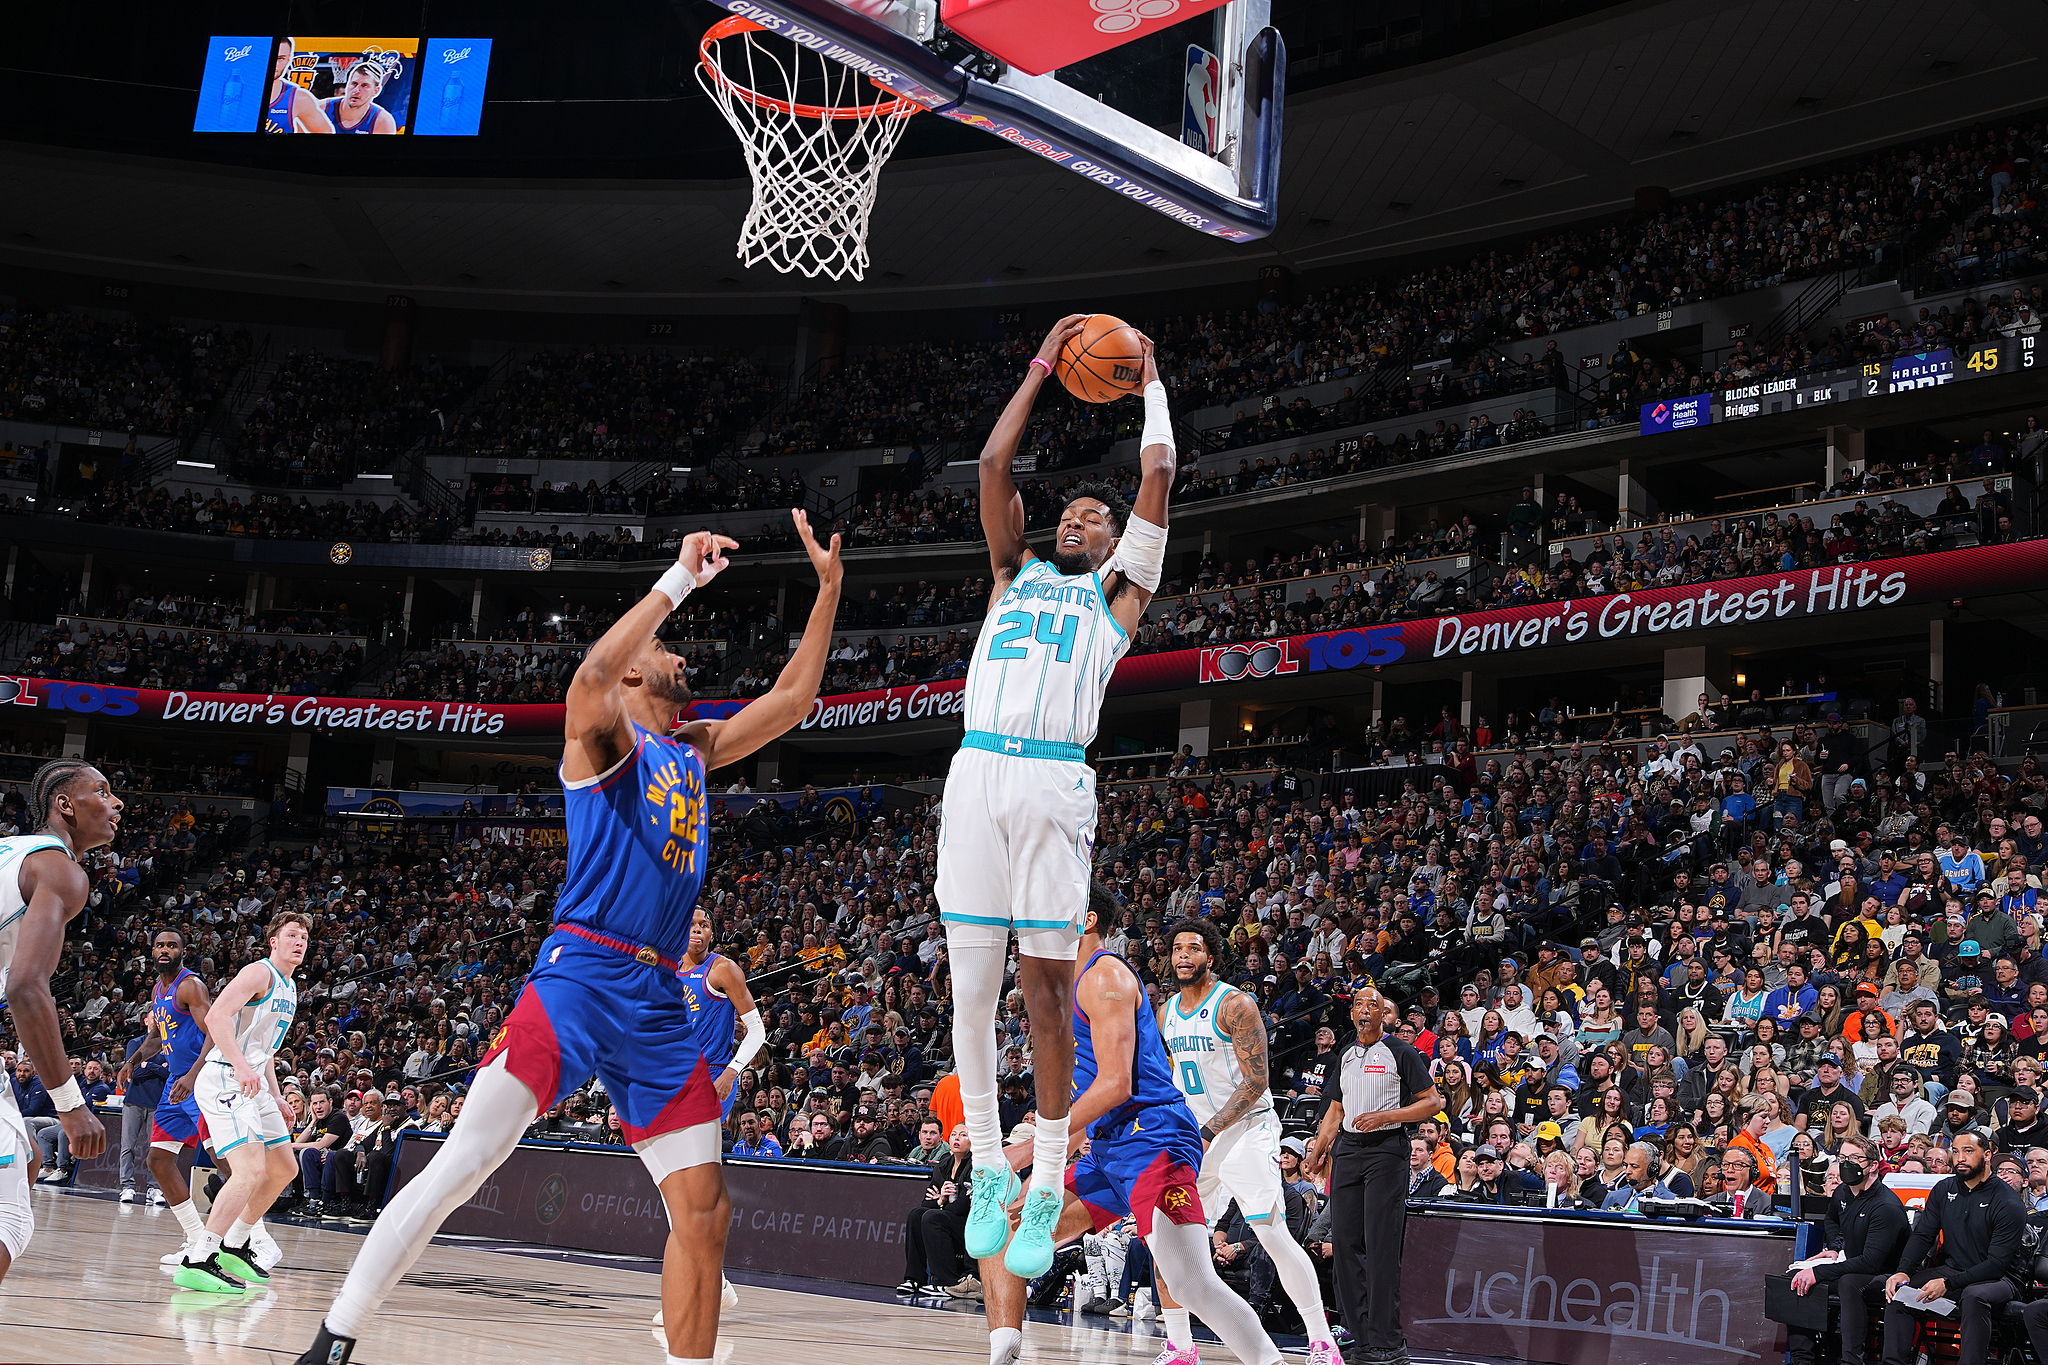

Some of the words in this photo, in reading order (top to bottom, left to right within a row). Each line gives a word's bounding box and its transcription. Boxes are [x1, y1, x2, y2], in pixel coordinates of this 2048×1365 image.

[727, 0, 787, 30] GIVES
[783, 25, 824, 49] YOU
[224, 45, 252, 61] Ball
[443, 47, 471, 63] Ball
[1186, 128, 1203, 151] NBA
[998, 127, 1033, 148] Red
[1032, 137, 1074, 163] Bull
[1070, 160, 1121, 186] GIVES
[1115, 180, 1153, 202] YOU
[1657, 310, 1673, 320] 380
[650, 324, 672, 334] 372
[1658, 320, 1670, 330] EXIT
[1731, 328, 1746, 339] 302
[2021, 336, 2035, 350] TO
[1586, 358, 1600, 368] 378
[1966, 348, 1999, 373] 45
[2023, 351, 2035, 368] 5
[1113, 363, 1139, 383] Wil
[1863, 363, 1881, 377] FLS
[1725, 385, 1760, 402] BLOCKS
[1763, 378, 1797, 395] LEADER
[1867, 379, 1879, 395] 2
[1672, 400, 1698, 412] Select
[1725, 402, 1760, 418] Bridges
[1813, 388, 1832, 402] BLK
[1672, 409, 1697, 420] Health
[883, 448, 895, 456] 374
[1339, 440, 1358, 453] 379
[825, 479, 836, 487] 372
[1995, 478, 2012, 491] EXIT
[260, 494, 279, 505] 369
[1457, 557, 1469, 568] EXIT
[1432, 601, 1590, 659] Denver's
[1597, 578, 1796, 639] Greatest
[1805, 567, 1908, 614] Hits
[987, 610, 1080, 664] 24
[1300, 626, 1406, 672] 105
[41, 681, 140, 716] 105
[162, 691, 286, 726] Denver's
[290, 694, 433, 731] Greatest
[438, 702, 505, 734] Hits
[800, 689, 903, 730] Denver's
[907, 684, 966, 720] Grea
[1851, 725, 1868, 738] EXIT
[646, 762, 682, 808] MILE
[1284, 779, 1296, 791] 50
[670, 791, 699, 844] 22
[482, 826, 525, 847] CAM'S
[661, 838, 696, 874] CITY
[1944, 868, 1970, 879] DENVER
[1439, 940, 1449, 950] 15
[1692, 999, 1705, 1012] 27
[272, 1019, 290, 1050] 7
[1902, 1042, 1940, 1062] DENVER
[2037, 1051, 2048, 1061] BE
[1180, 1060, 1205, 1096] 0
[580, 1192, 662, 1220] OFFICIAL
[751, 1209, 805, 1234] CARE
[1444, 1246, 1732, 1345] uchealth
